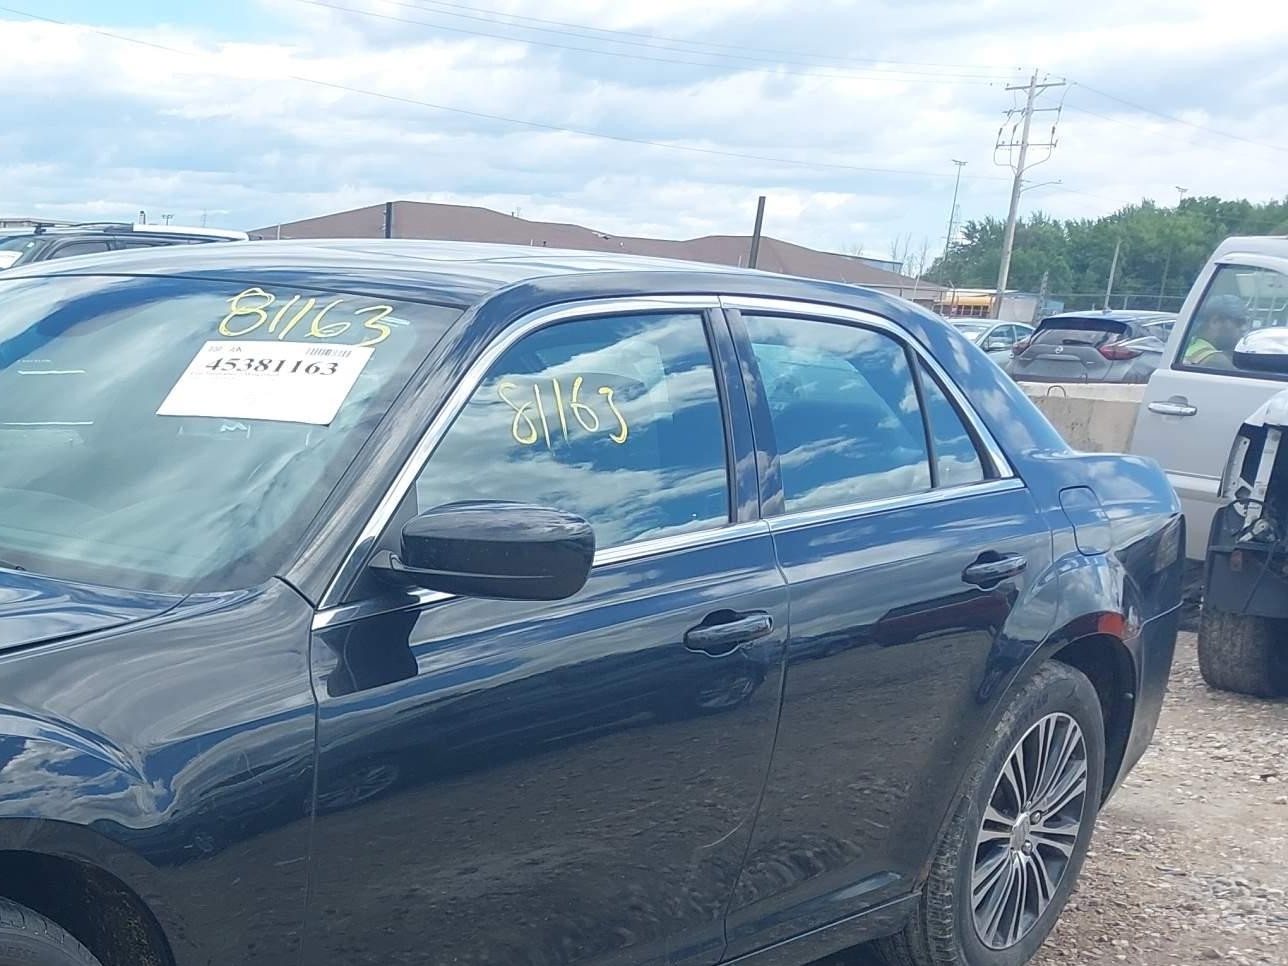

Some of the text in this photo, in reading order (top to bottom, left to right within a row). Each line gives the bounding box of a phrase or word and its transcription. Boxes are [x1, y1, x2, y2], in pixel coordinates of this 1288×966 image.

[218, 287, 394, 347] 81163
[205, 357, 339, 376] 45381163
[497, 376, 629, 451] 81163
